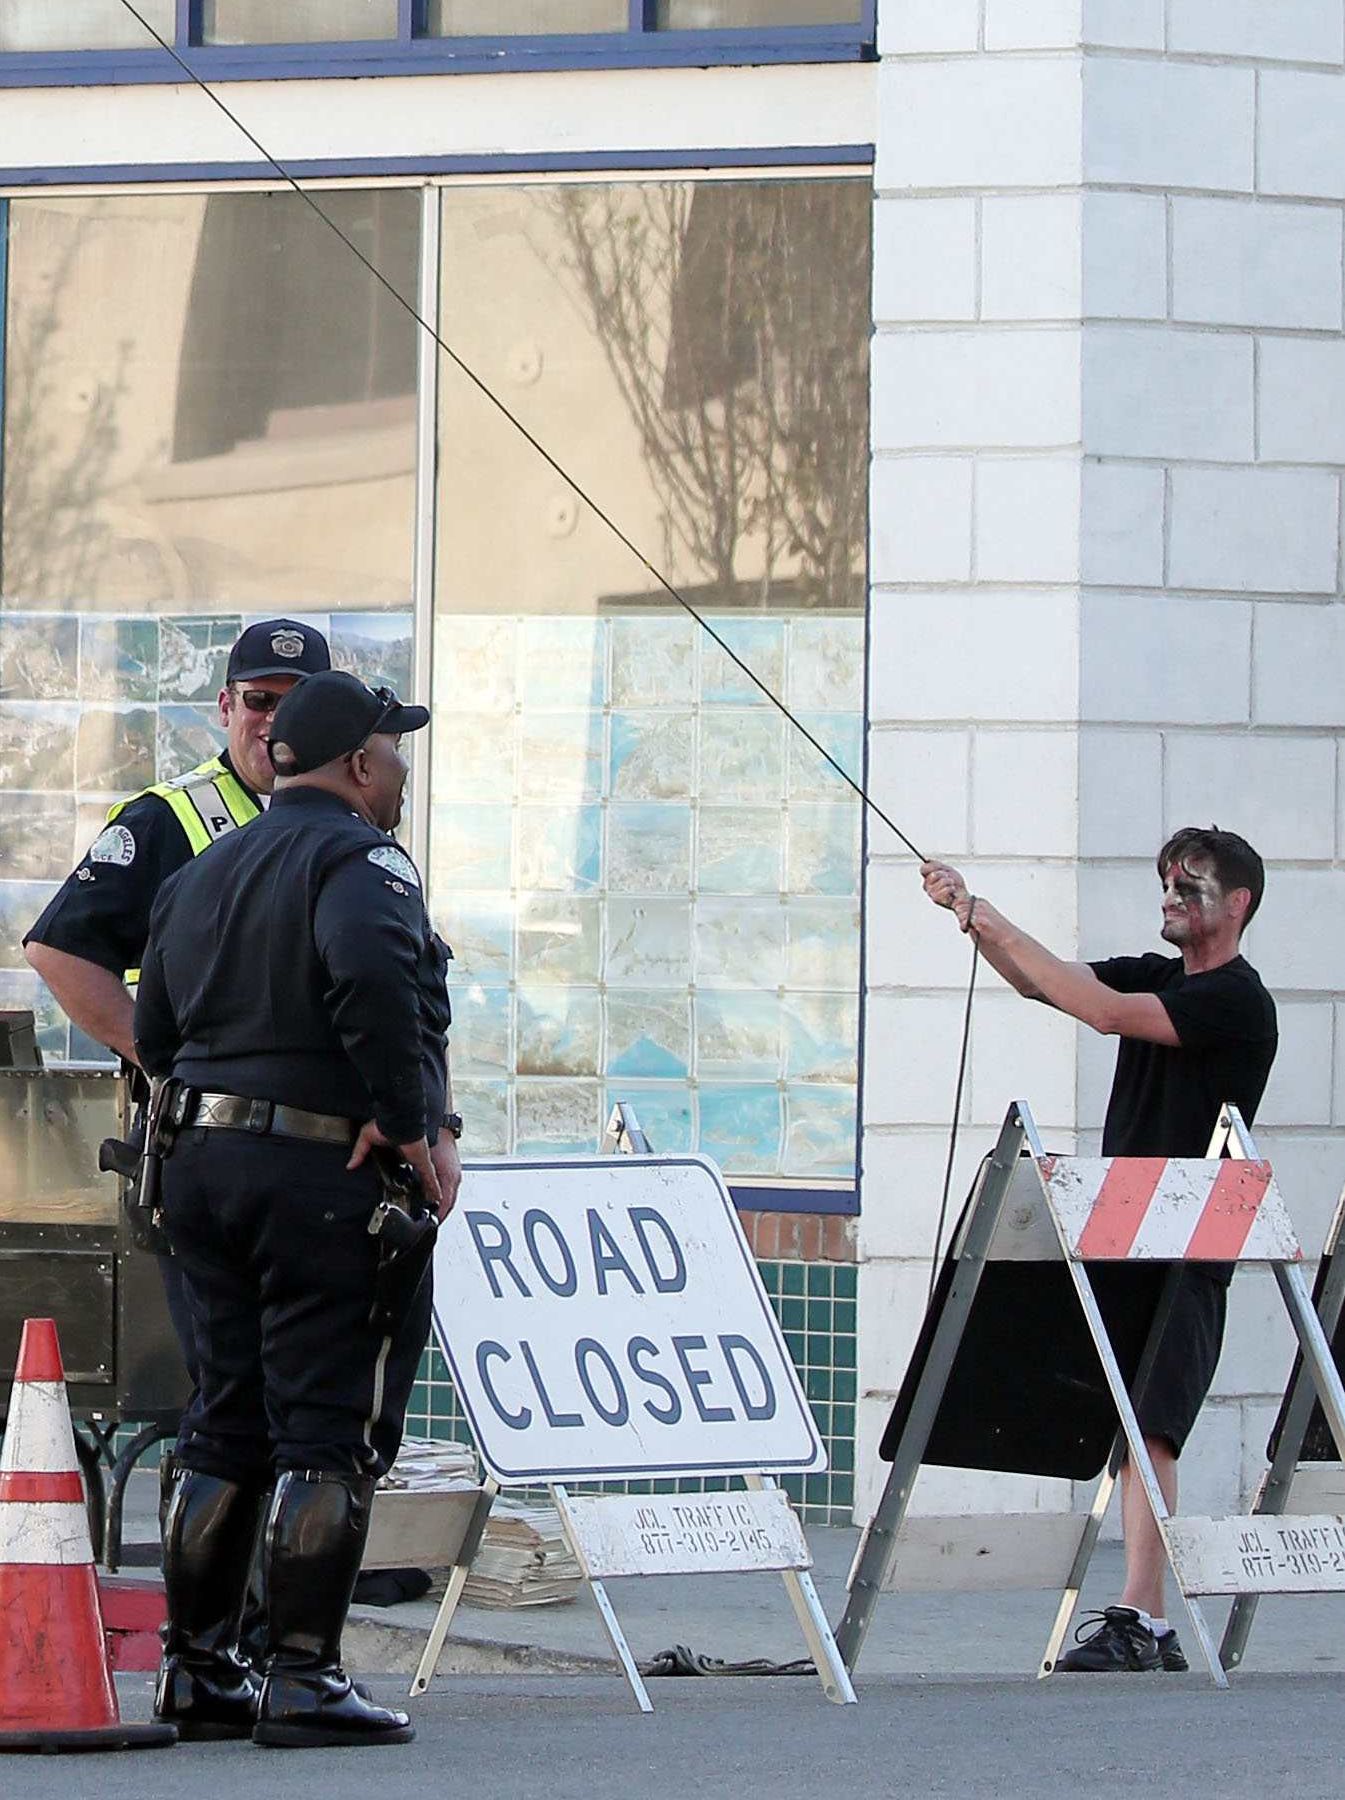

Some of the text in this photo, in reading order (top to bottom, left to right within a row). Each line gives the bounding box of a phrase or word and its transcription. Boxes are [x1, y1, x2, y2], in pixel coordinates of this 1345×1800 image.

[210, 816, 229, 832] P
[464, 1206, 687, 1298] ROAD
[476, 1334, 777, 1431] CLOSED
[635, 1503, 751, 1530] JCL TRAFFIC
[640, 1528, 772, 1554] 877-319-2145
[1238, 1526, 1345, 1553] JCL TRAFFI
[1241, 1551, 1345, 1577] 877-319-2
